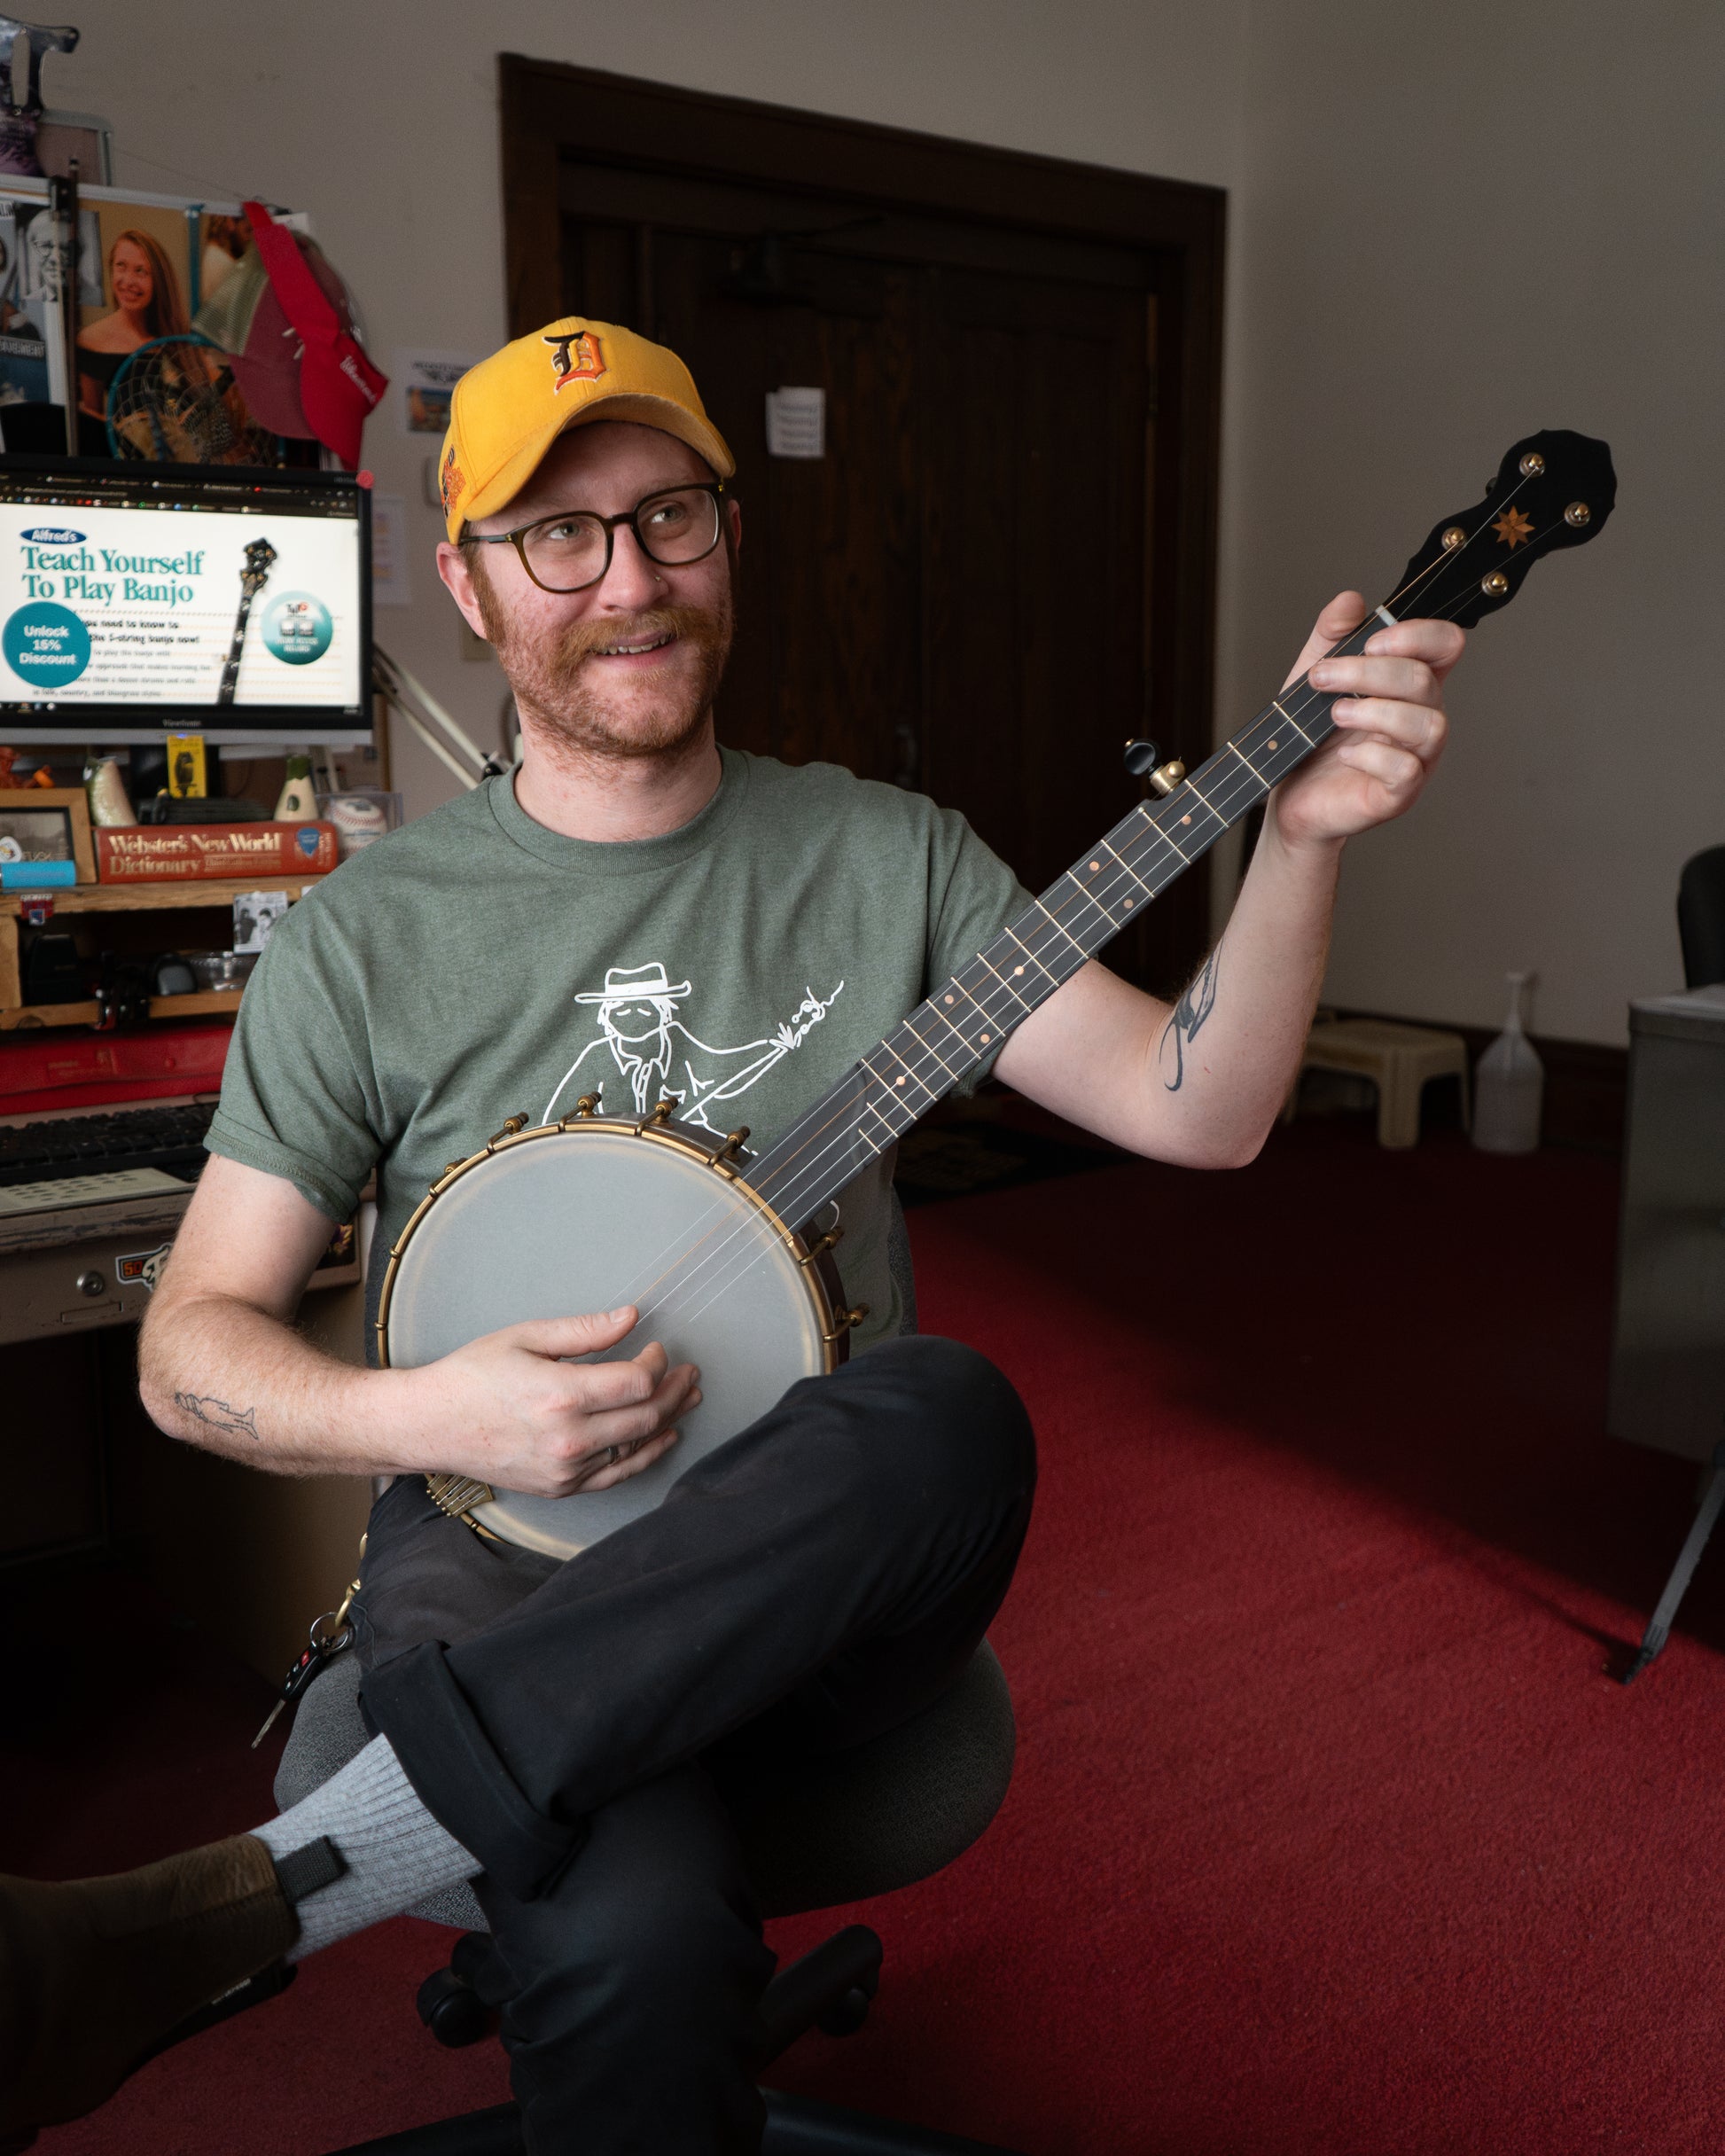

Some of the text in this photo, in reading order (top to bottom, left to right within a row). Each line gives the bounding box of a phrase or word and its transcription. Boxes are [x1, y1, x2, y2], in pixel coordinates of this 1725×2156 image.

[542, 331, 606, 395] D
[31, 529, 77, 543] Alfred's
[20, 546, 206, 575] Teach Yourself
[21, 574, 194, 609] To Play Banjo
[24, 625, 69, 637] Unlock
[32, 639, 62, 652] 15%
[19, 652, 77, 665] Discount
[108, 834, 188, 855] Webster's
[191, 832, 228, 852] New
[229, 832, 283, 852] World
[109, 854, 201, 876] Dictionary
